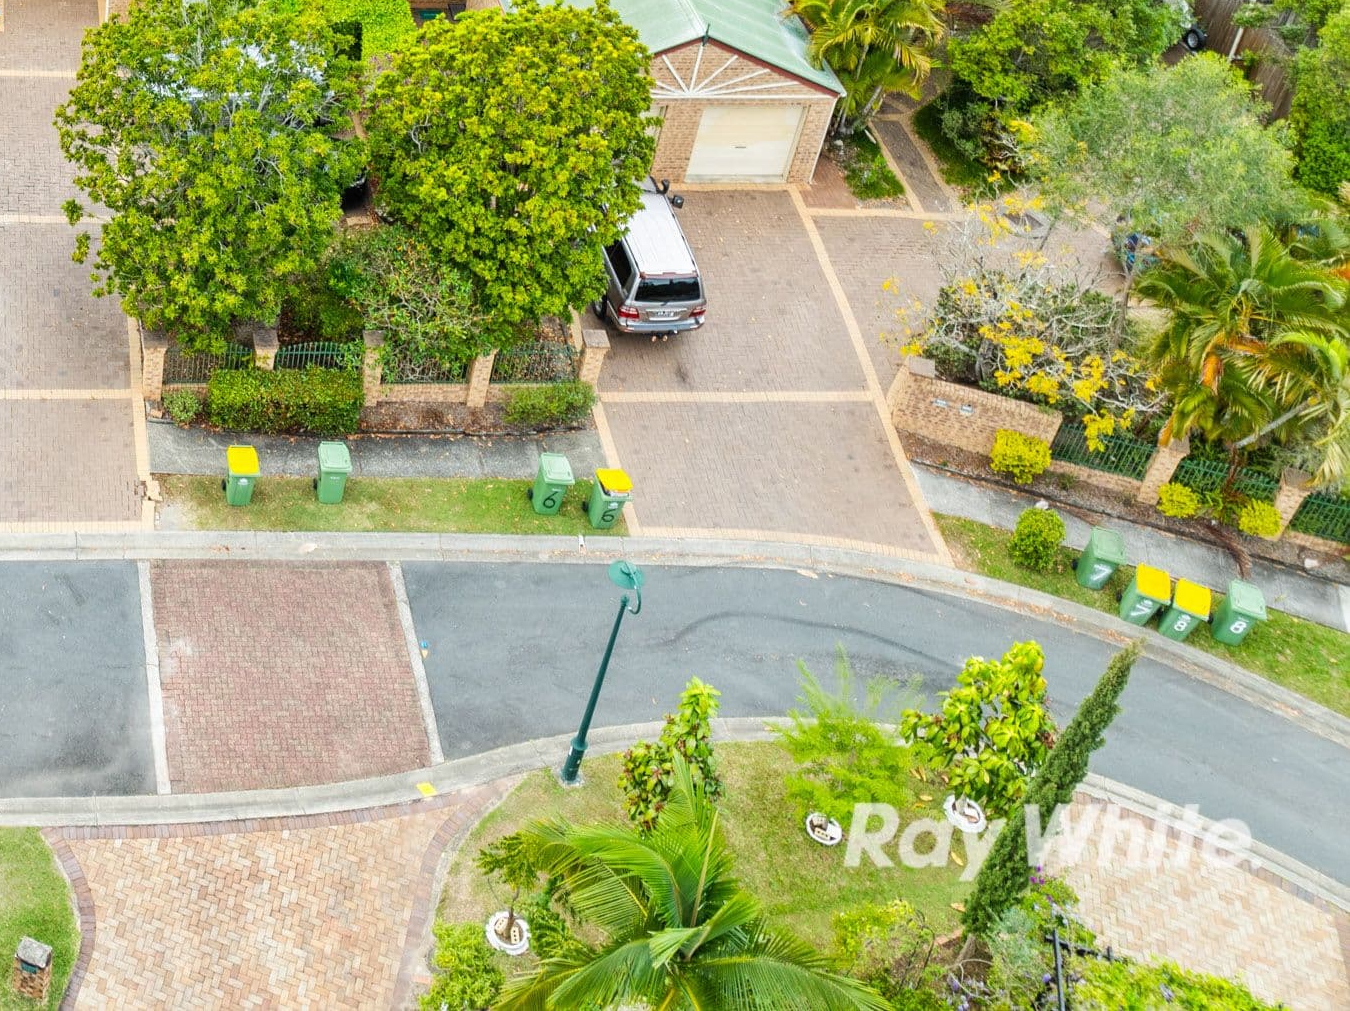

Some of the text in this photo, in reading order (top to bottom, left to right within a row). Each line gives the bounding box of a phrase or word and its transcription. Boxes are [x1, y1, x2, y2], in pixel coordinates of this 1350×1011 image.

[543, 490, 558, 509] 6
[602, 508, 616, 522] 6
[1091, 562, 1112, 581] 7
[1174, 619, 1188, 631] 8
[1230, 620, 1247, 634] 8
